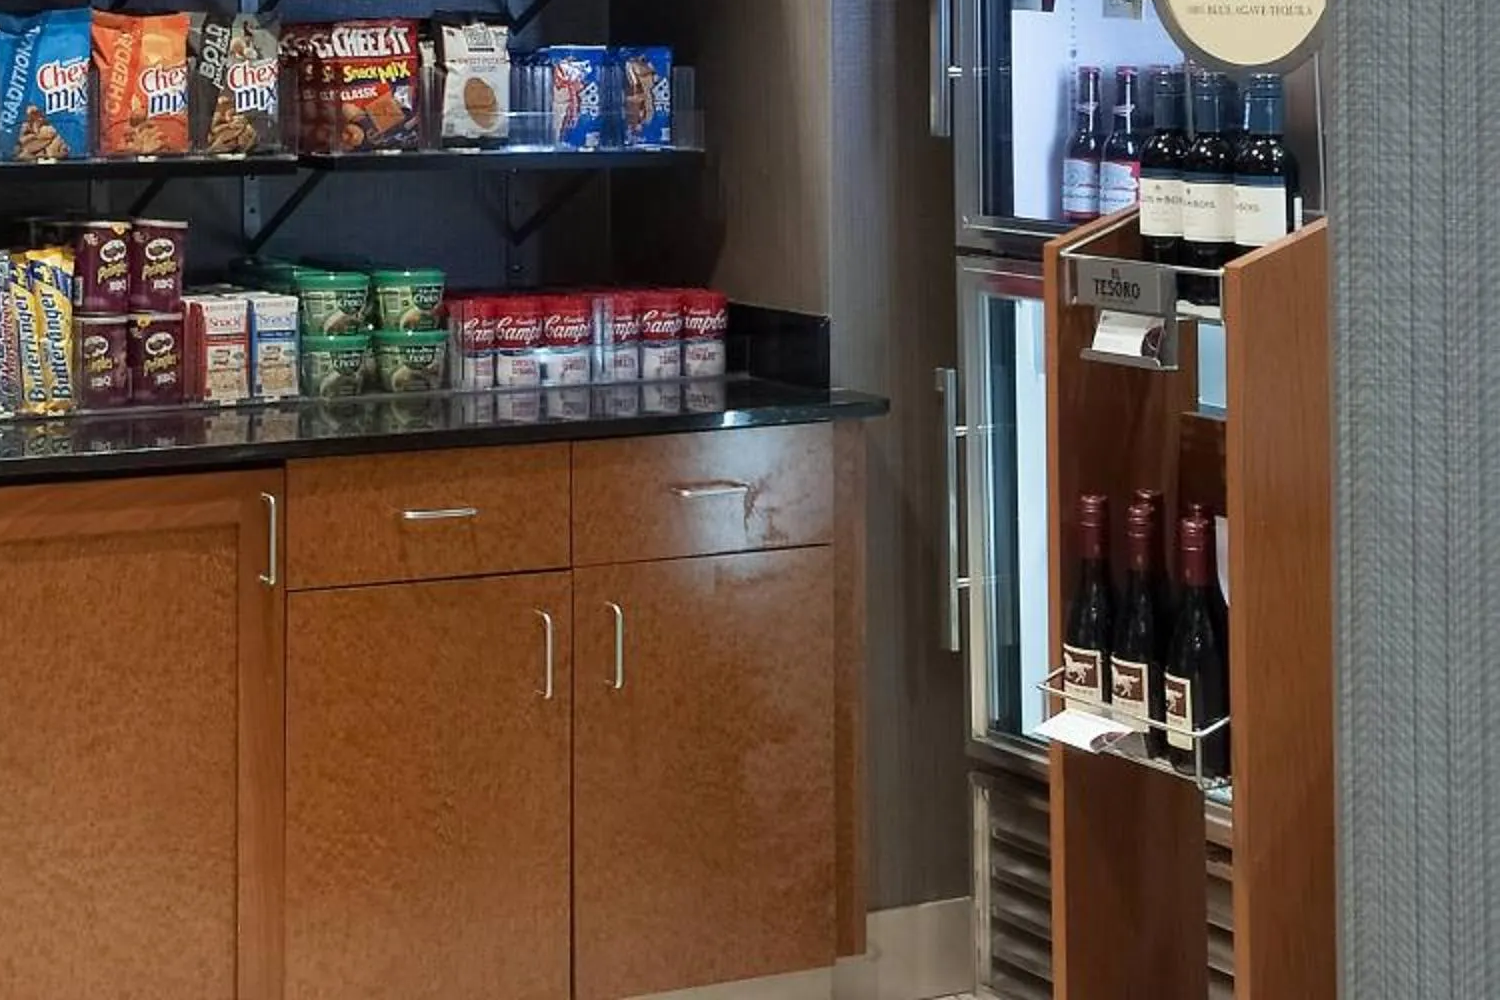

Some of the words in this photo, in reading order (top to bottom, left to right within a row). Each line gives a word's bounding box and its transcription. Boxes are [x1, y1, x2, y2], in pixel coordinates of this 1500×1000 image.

[200, 23, 223, 78] BOLD
[331, 26, 411, 57] CHEEZ-IT
[229, 61, 278, 91] Chex
[236, 86, 278, 112] mix
[1092, 278, 1141, 299] TESORO
